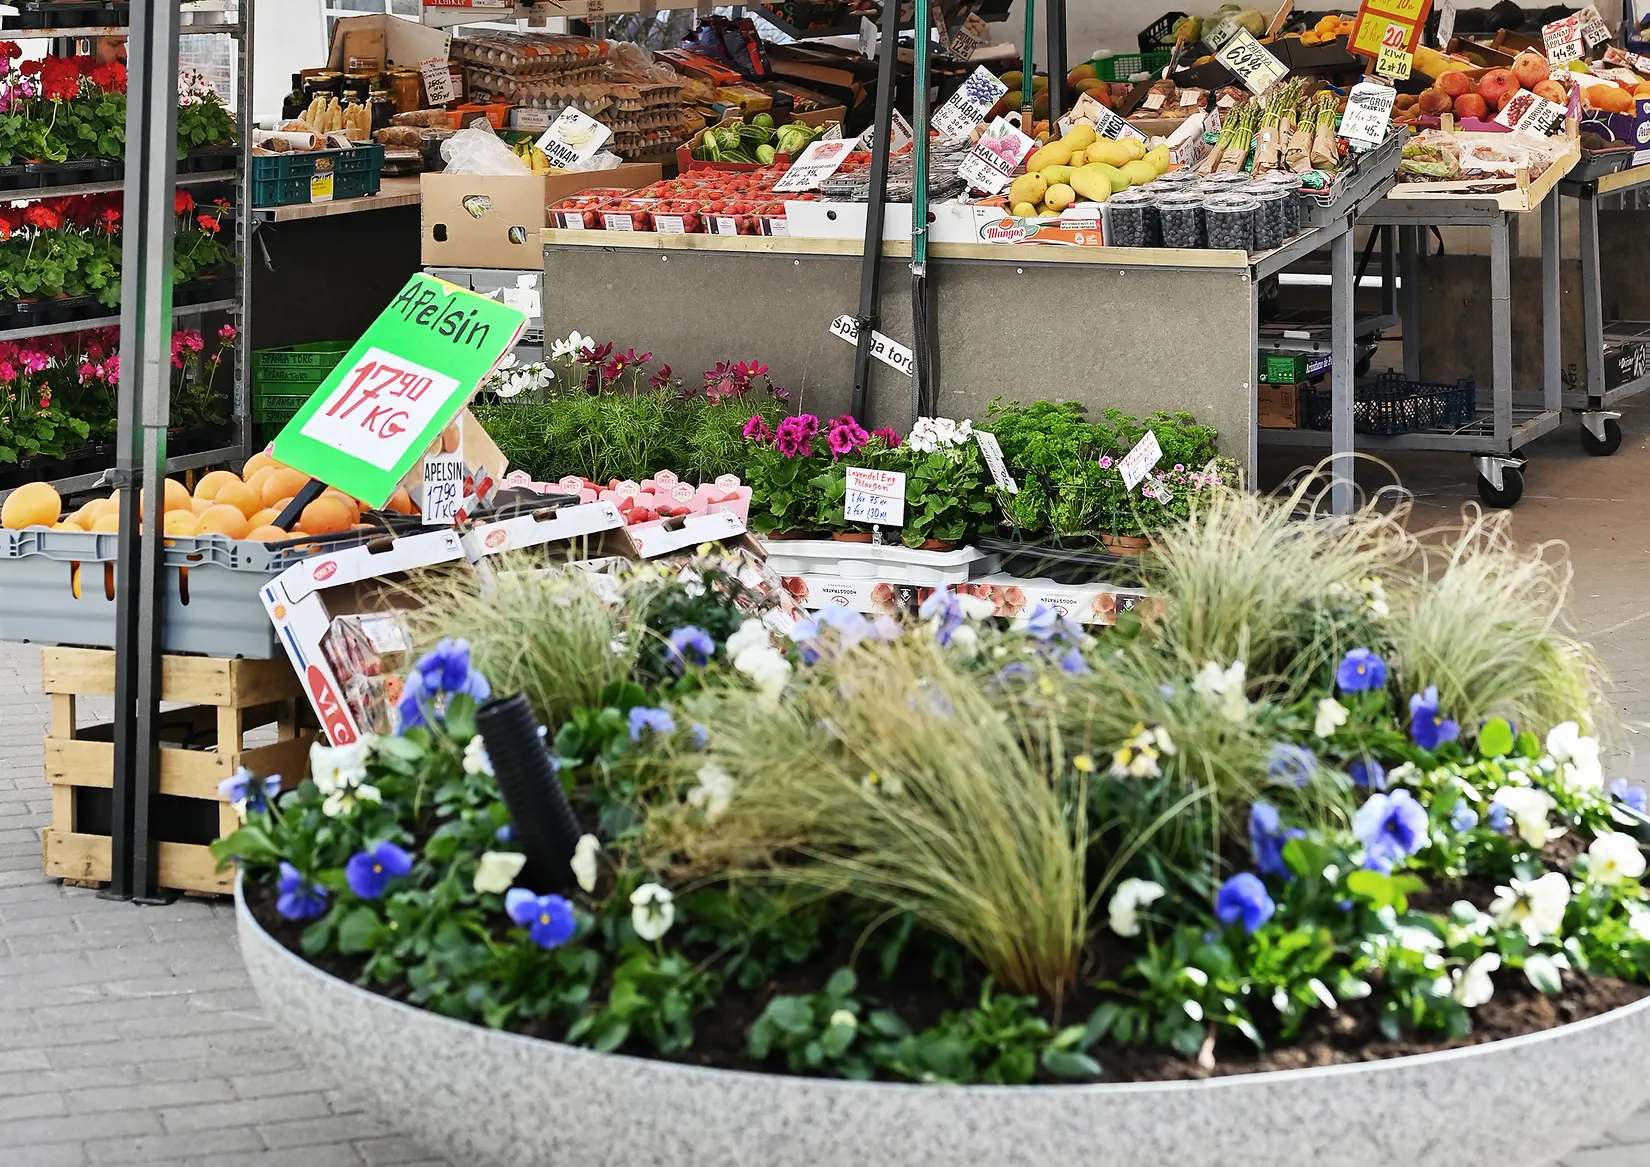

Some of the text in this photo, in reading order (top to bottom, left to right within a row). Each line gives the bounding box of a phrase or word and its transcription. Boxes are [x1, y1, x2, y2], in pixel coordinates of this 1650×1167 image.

[1359, 21, 1371, 40] 3
[1382, 27, 1404, 47] 20
[1247, 41, 1273, 66] PAPAYA
[1384, 48, 1406, 60] KIWI
[1379, 58, 1386, 71] 2
[950, 93, 984, 125] BLÅBÄR
[1370, 96, 1392, 109] GRÖN
[545, 139, 580, 164] BANAN
[981, 164, 991, 173] 30
[975, 172, 986, 182] 50
[987, 227, 1024, 240] Mangos
[290, 354, 313, 364] TORG
[888, 347, 913, 375] torg
[360, 405, 409, 439] KG
[424, 462, 462, 481] APELSIN
[1041, 597, 1077, 605] HOOGSTRATEN
